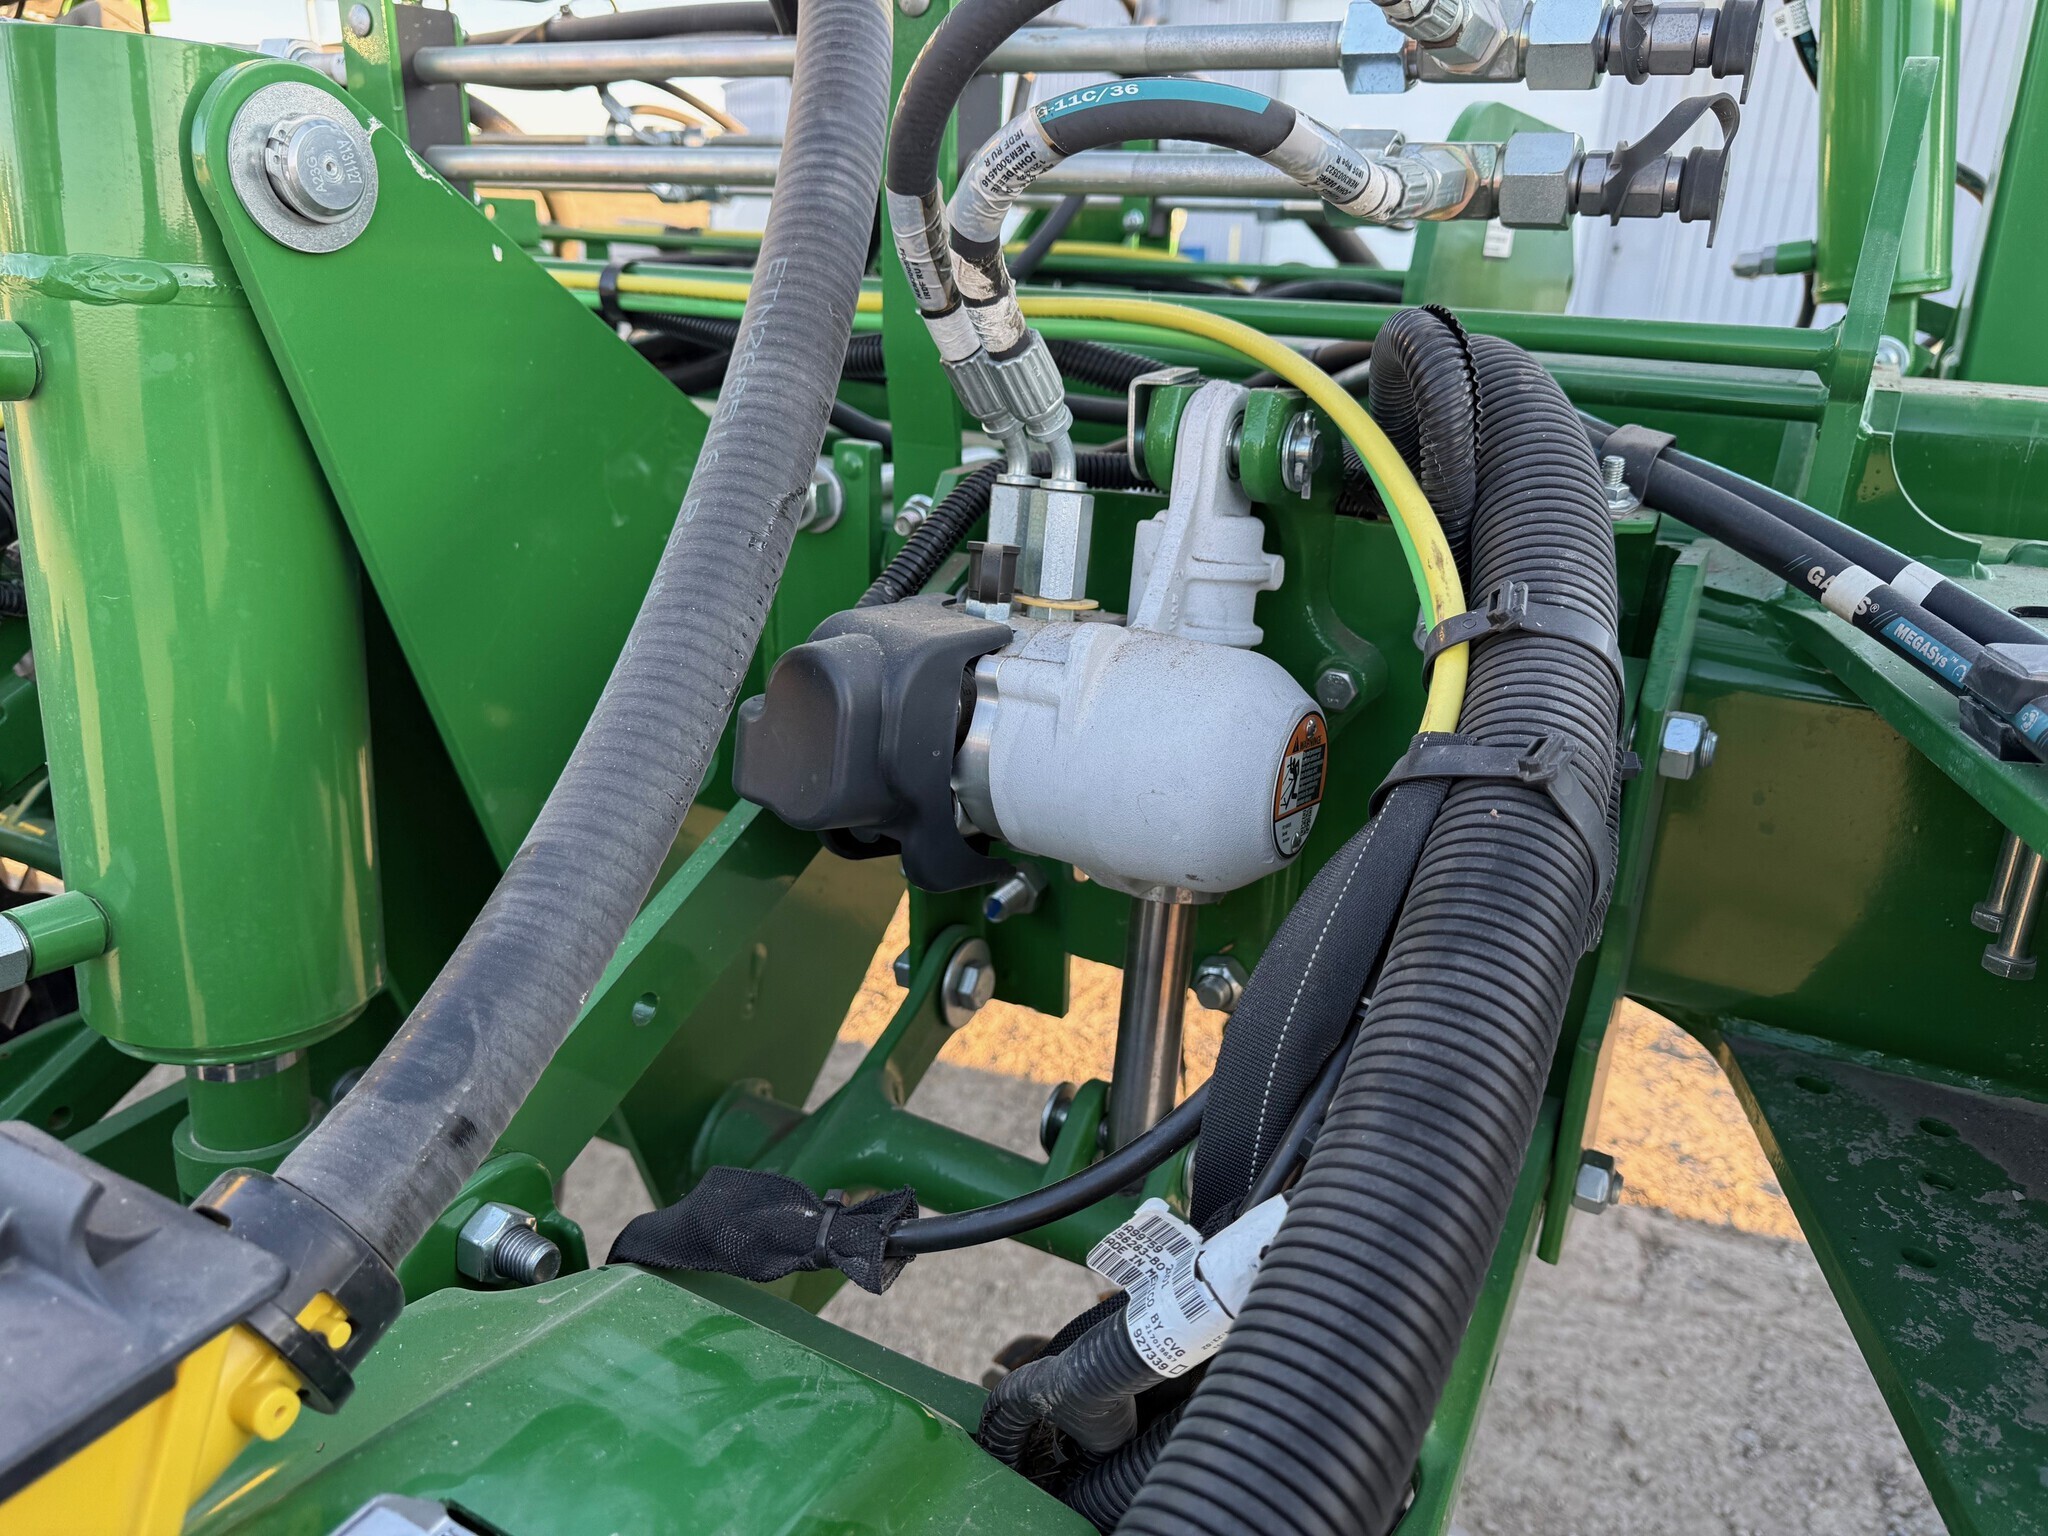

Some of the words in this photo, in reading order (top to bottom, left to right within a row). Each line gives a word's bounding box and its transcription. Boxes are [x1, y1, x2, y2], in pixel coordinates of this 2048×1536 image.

[336, 140, 363, 184] A131127
[1011, 150, 1038, 175] JOHN
[1334, 184, 1352, 196] JOHN
[1893, 622, 1949, 669] MEGASys
[1120, 1223, 1164, 1254] A99759
[1128, 1254, 1147, 1268] IN
[1150, 1312, 1165, 1332] BY
[1163, 1336, 1187, 1358] CVG
[1133, 1327, 1170, 1371] 927339
